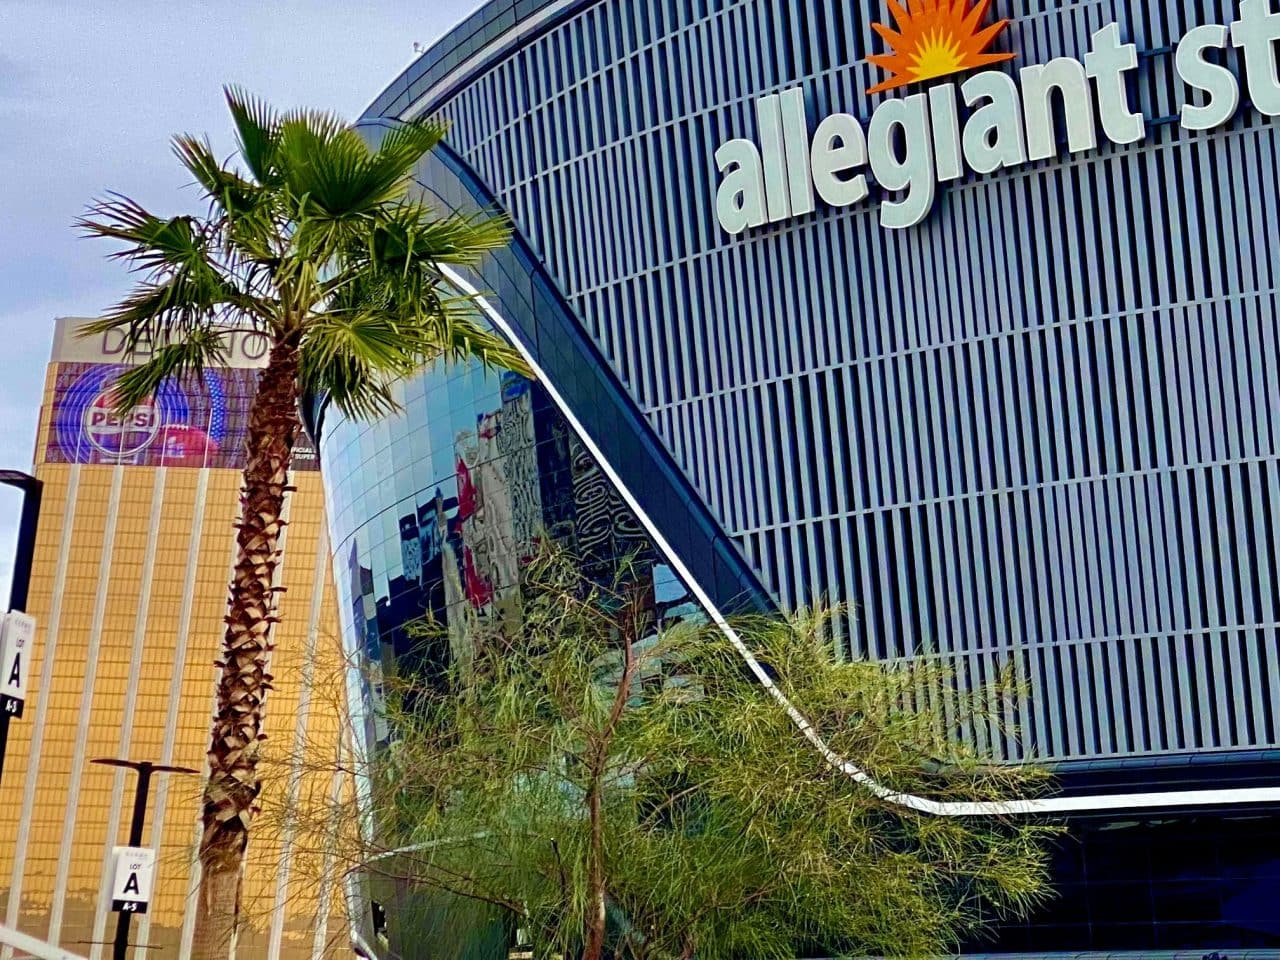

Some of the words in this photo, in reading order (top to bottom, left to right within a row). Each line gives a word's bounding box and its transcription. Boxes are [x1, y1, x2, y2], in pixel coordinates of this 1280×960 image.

[715, 21, 1146, 235] allegiant
[8, 652, 20, 689] A
[123, 872, 139, 895] A
